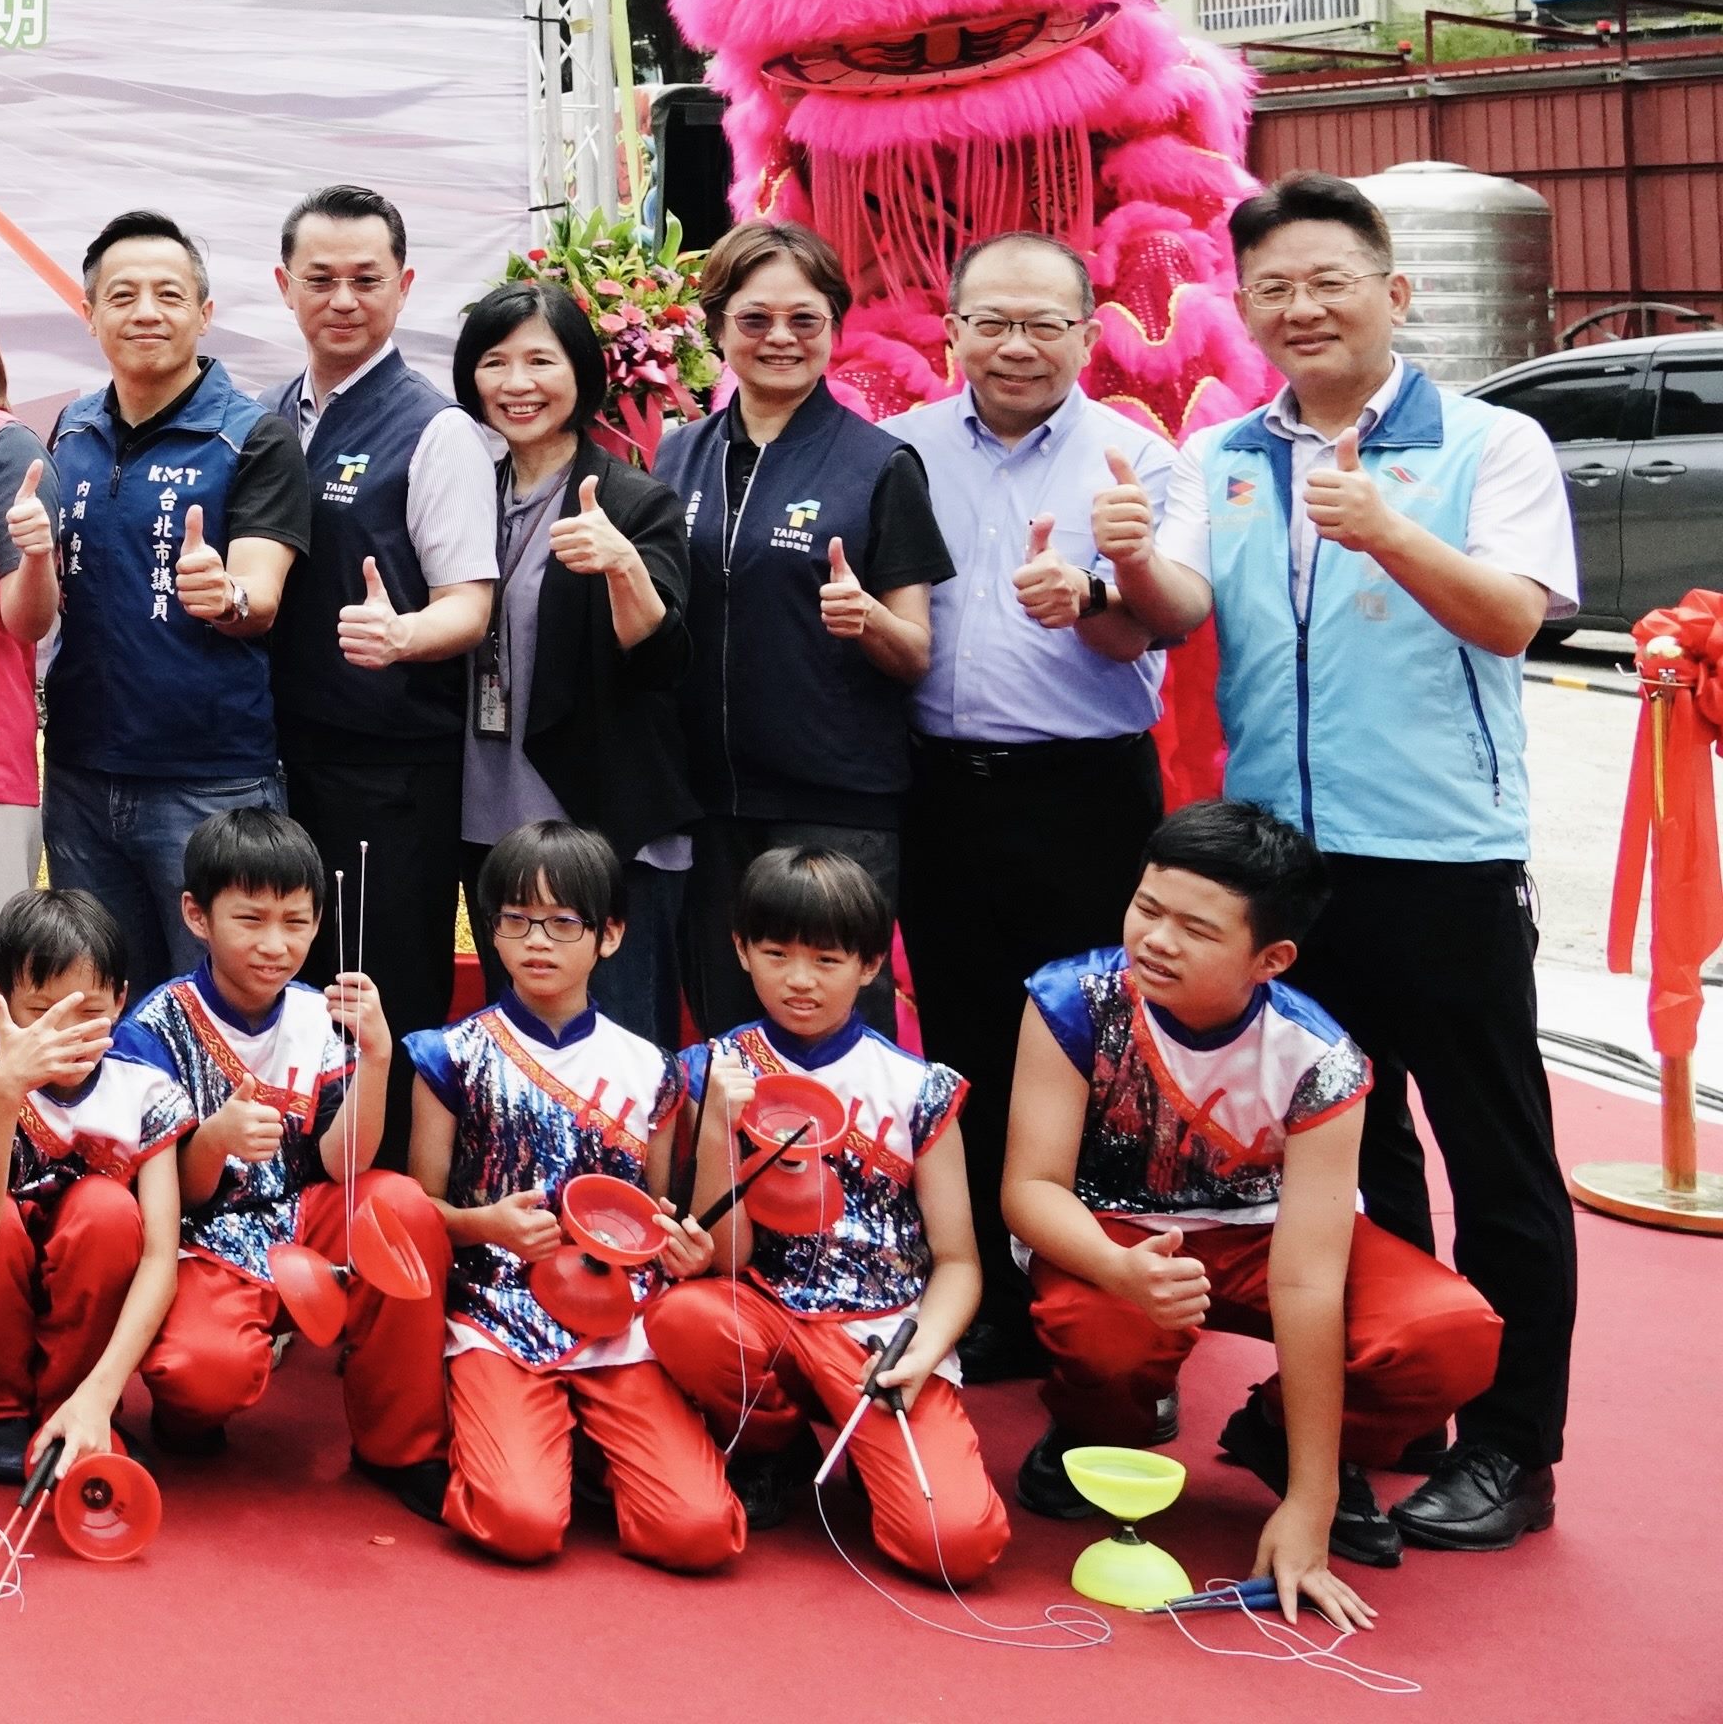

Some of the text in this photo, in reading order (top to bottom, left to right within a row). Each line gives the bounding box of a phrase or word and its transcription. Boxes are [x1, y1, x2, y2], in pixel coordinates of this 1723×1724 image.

[147, 465, 202, 486] KMT
[325, 481, 359, 495] TAIPEI
[773, 527, 813, 543] TAIPEI
[150, 487, 175, 622] 台北市議員
